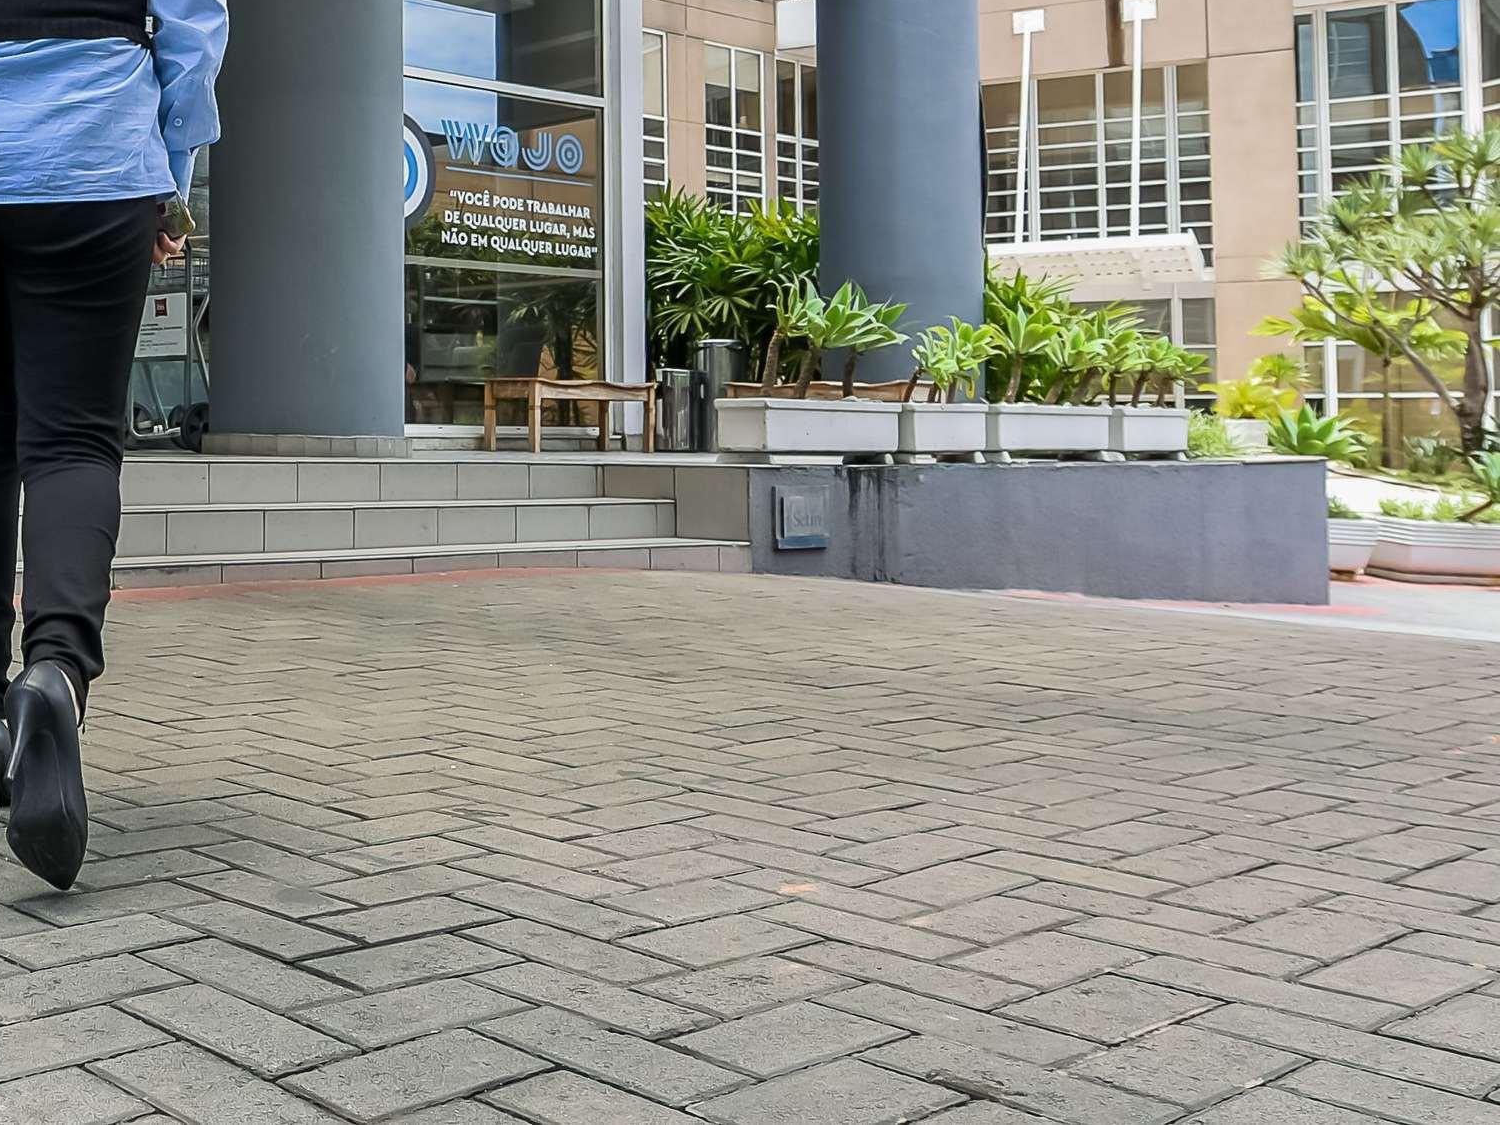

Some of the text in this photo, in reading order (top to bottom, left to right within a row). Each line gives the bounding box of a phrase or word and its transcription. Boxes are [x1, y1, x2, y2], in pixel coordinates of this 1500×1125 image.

[441, 119, 584, 175] WOJO
[449, 189, 591, 219] “VOCÊ PODE TRABALHAR
[444, 210, 595, 239] DE QUALQUER LUGAR, MAS
[441, 228, 468, 246] NÃO
[470, 233, 488, 247] EM
[490, 236, 553, 256] QUALQUER
